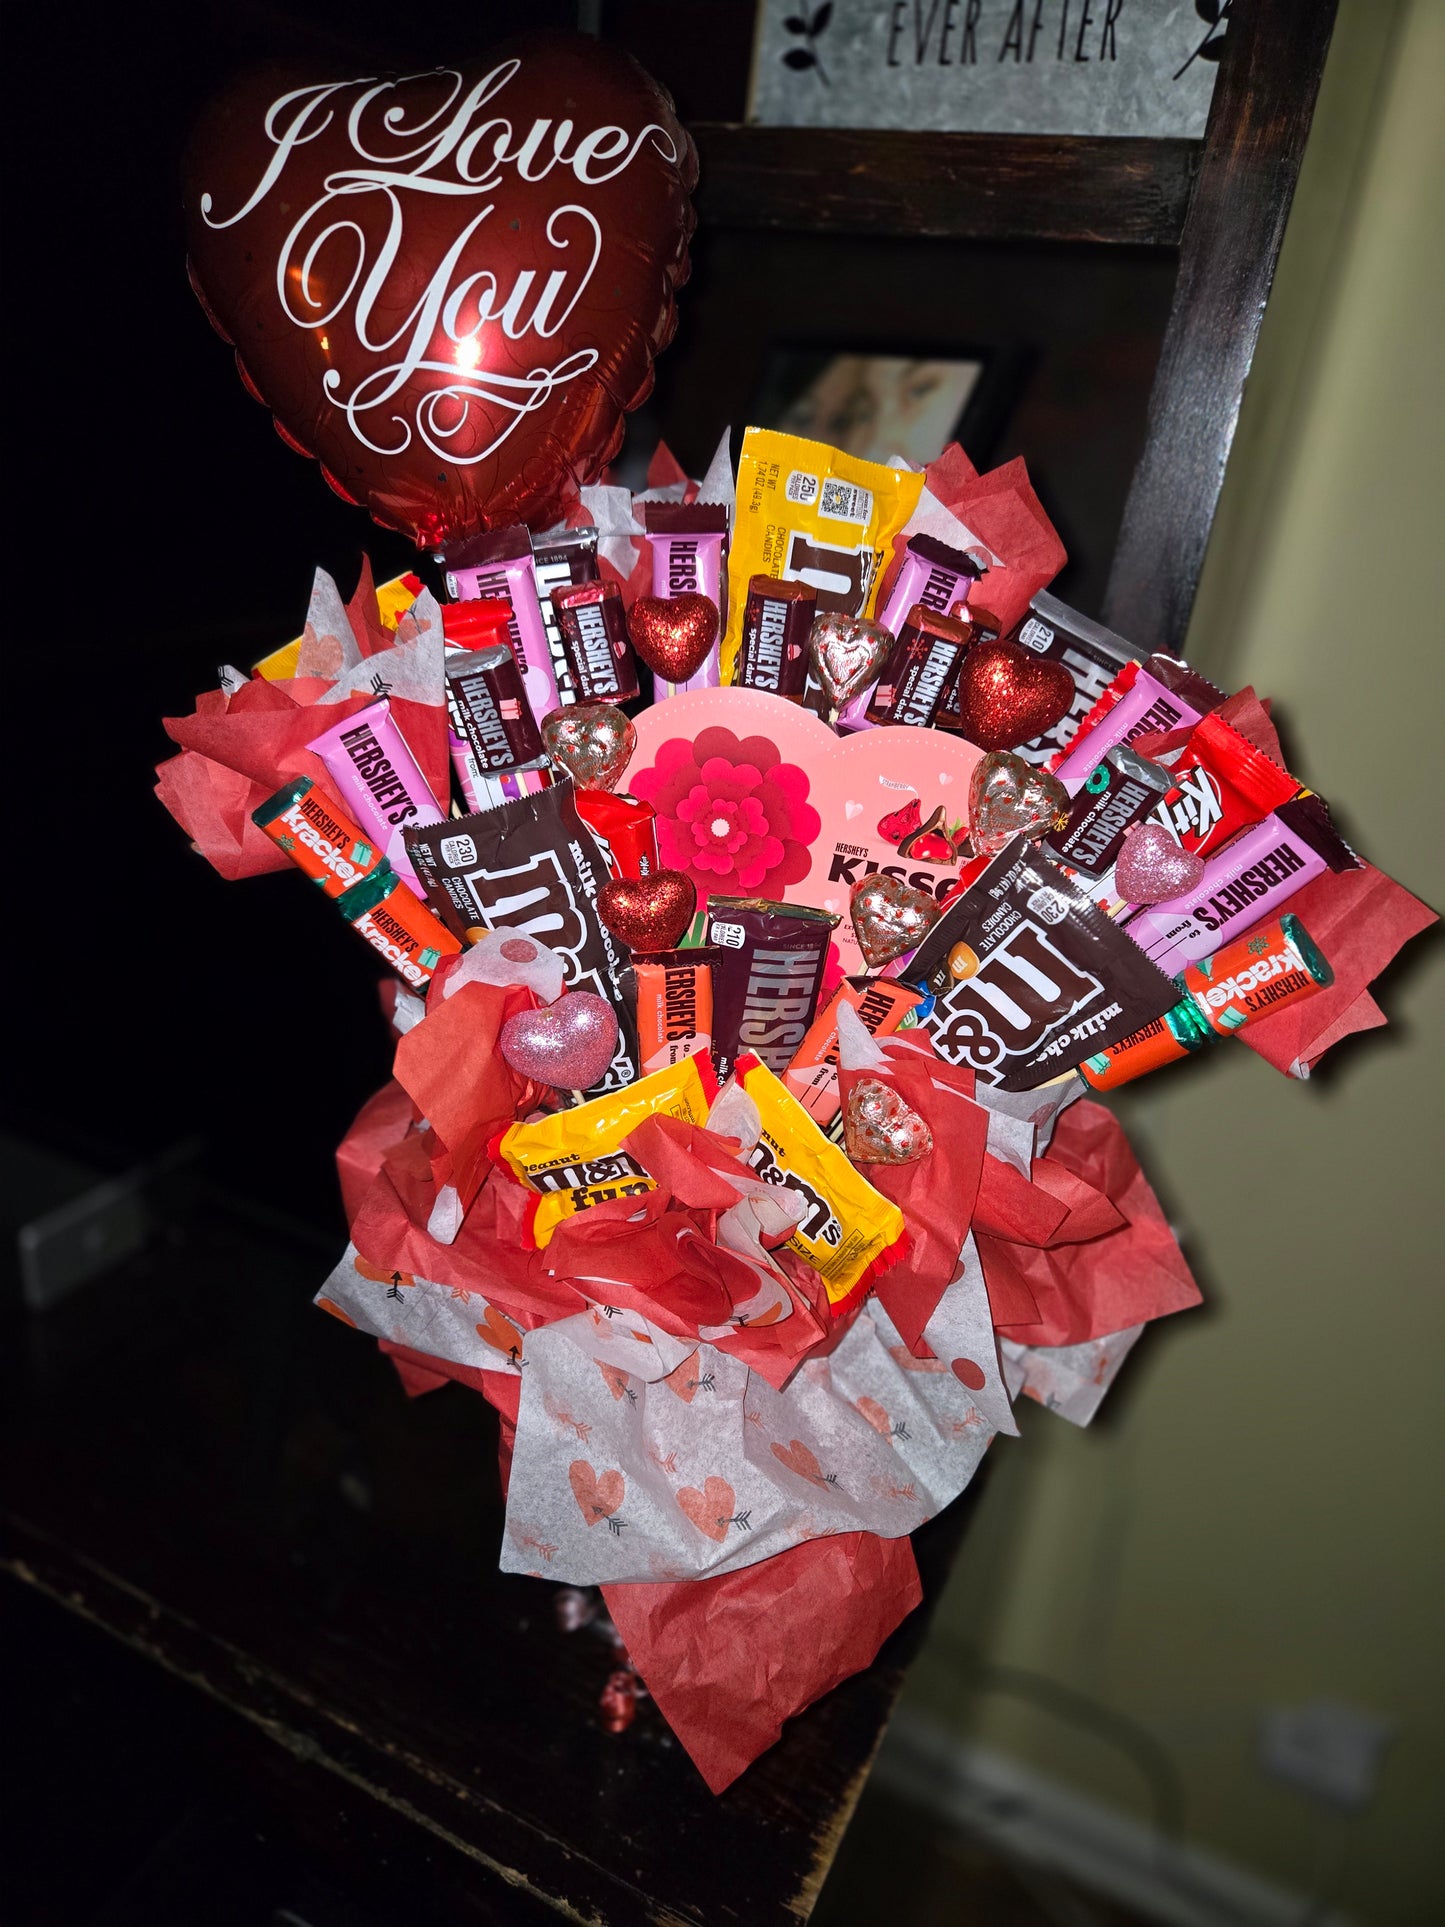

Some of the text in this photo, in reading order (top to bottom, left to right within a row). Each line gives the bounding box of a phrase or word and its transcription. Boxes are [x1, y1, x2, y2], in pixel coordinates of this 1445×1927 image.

[887, 0, 982, 66] EVER
[201, 59, 679, 230] I Love
[276, 181, 602, 464] You
[767, 462, 780, 491] NET WT
[762, 524, 776, 564] CANDIES
[576, 604, 619, 695] HERSHEY'S
[744, 628, 757, 686] special dark
[755, 599, 788, 691] HERSHEY'S
[1031, 626, 1052, 651] 210
[570, 641, 593, 697] special dark
[892, 664, 921, 721] special dark
[902, 639, 959, 728] HERSHEY'S
[457, 699, 471, 722] milk
[466, 722, 489, 770] chocolate
[460, 676, 515, 767] HERSHEY'S
[339, 722, 418, 826] HERSHEY'S
[301, 797, 351, 850] HERSHEY'S
[350, 773, 389, 832] milk chocolate
[1061, 790, 1113, 854] milk chocolate
[1072, 779, 1151, 867] HERSHEY'S
[455, 838, 475, 863] 230
[567, 838, 598, 899] milk
[834, 842, 870, 858] HERSHEY'S
[441, 877, 464, 910] CANDIES
[450, 876, 480, 921] CHOCOLATE
[1183, 862, 1244, 911] milk chocolate
[1191, 842, 1307, 933] HERSHEY'S
[371, 906, 420, 953] HERSHEY'S
[978, 910, 1023, 952] CHOCOLATE
[981, 901, 1013, 933] CANDIES
[1040, 899, 1065, 924] 230
[1165, 918, 1193, 940] from
[1188, 928, 1201, 940] to
[726, 926, 742, 948] 210
[665, 966, 697, 1042] ERSHEY'S
[1245, 970, 1311, 1014] HERSHEY'S
[1076, 1001, 1123, 1043] milk
[1111, 1018, 1165, 1056] HERSHEY'S
[718, 1056, 729, 1075] milk
[811, 1067, 829, 1086] from
[790, 1236, 821, 1265] SIZE
